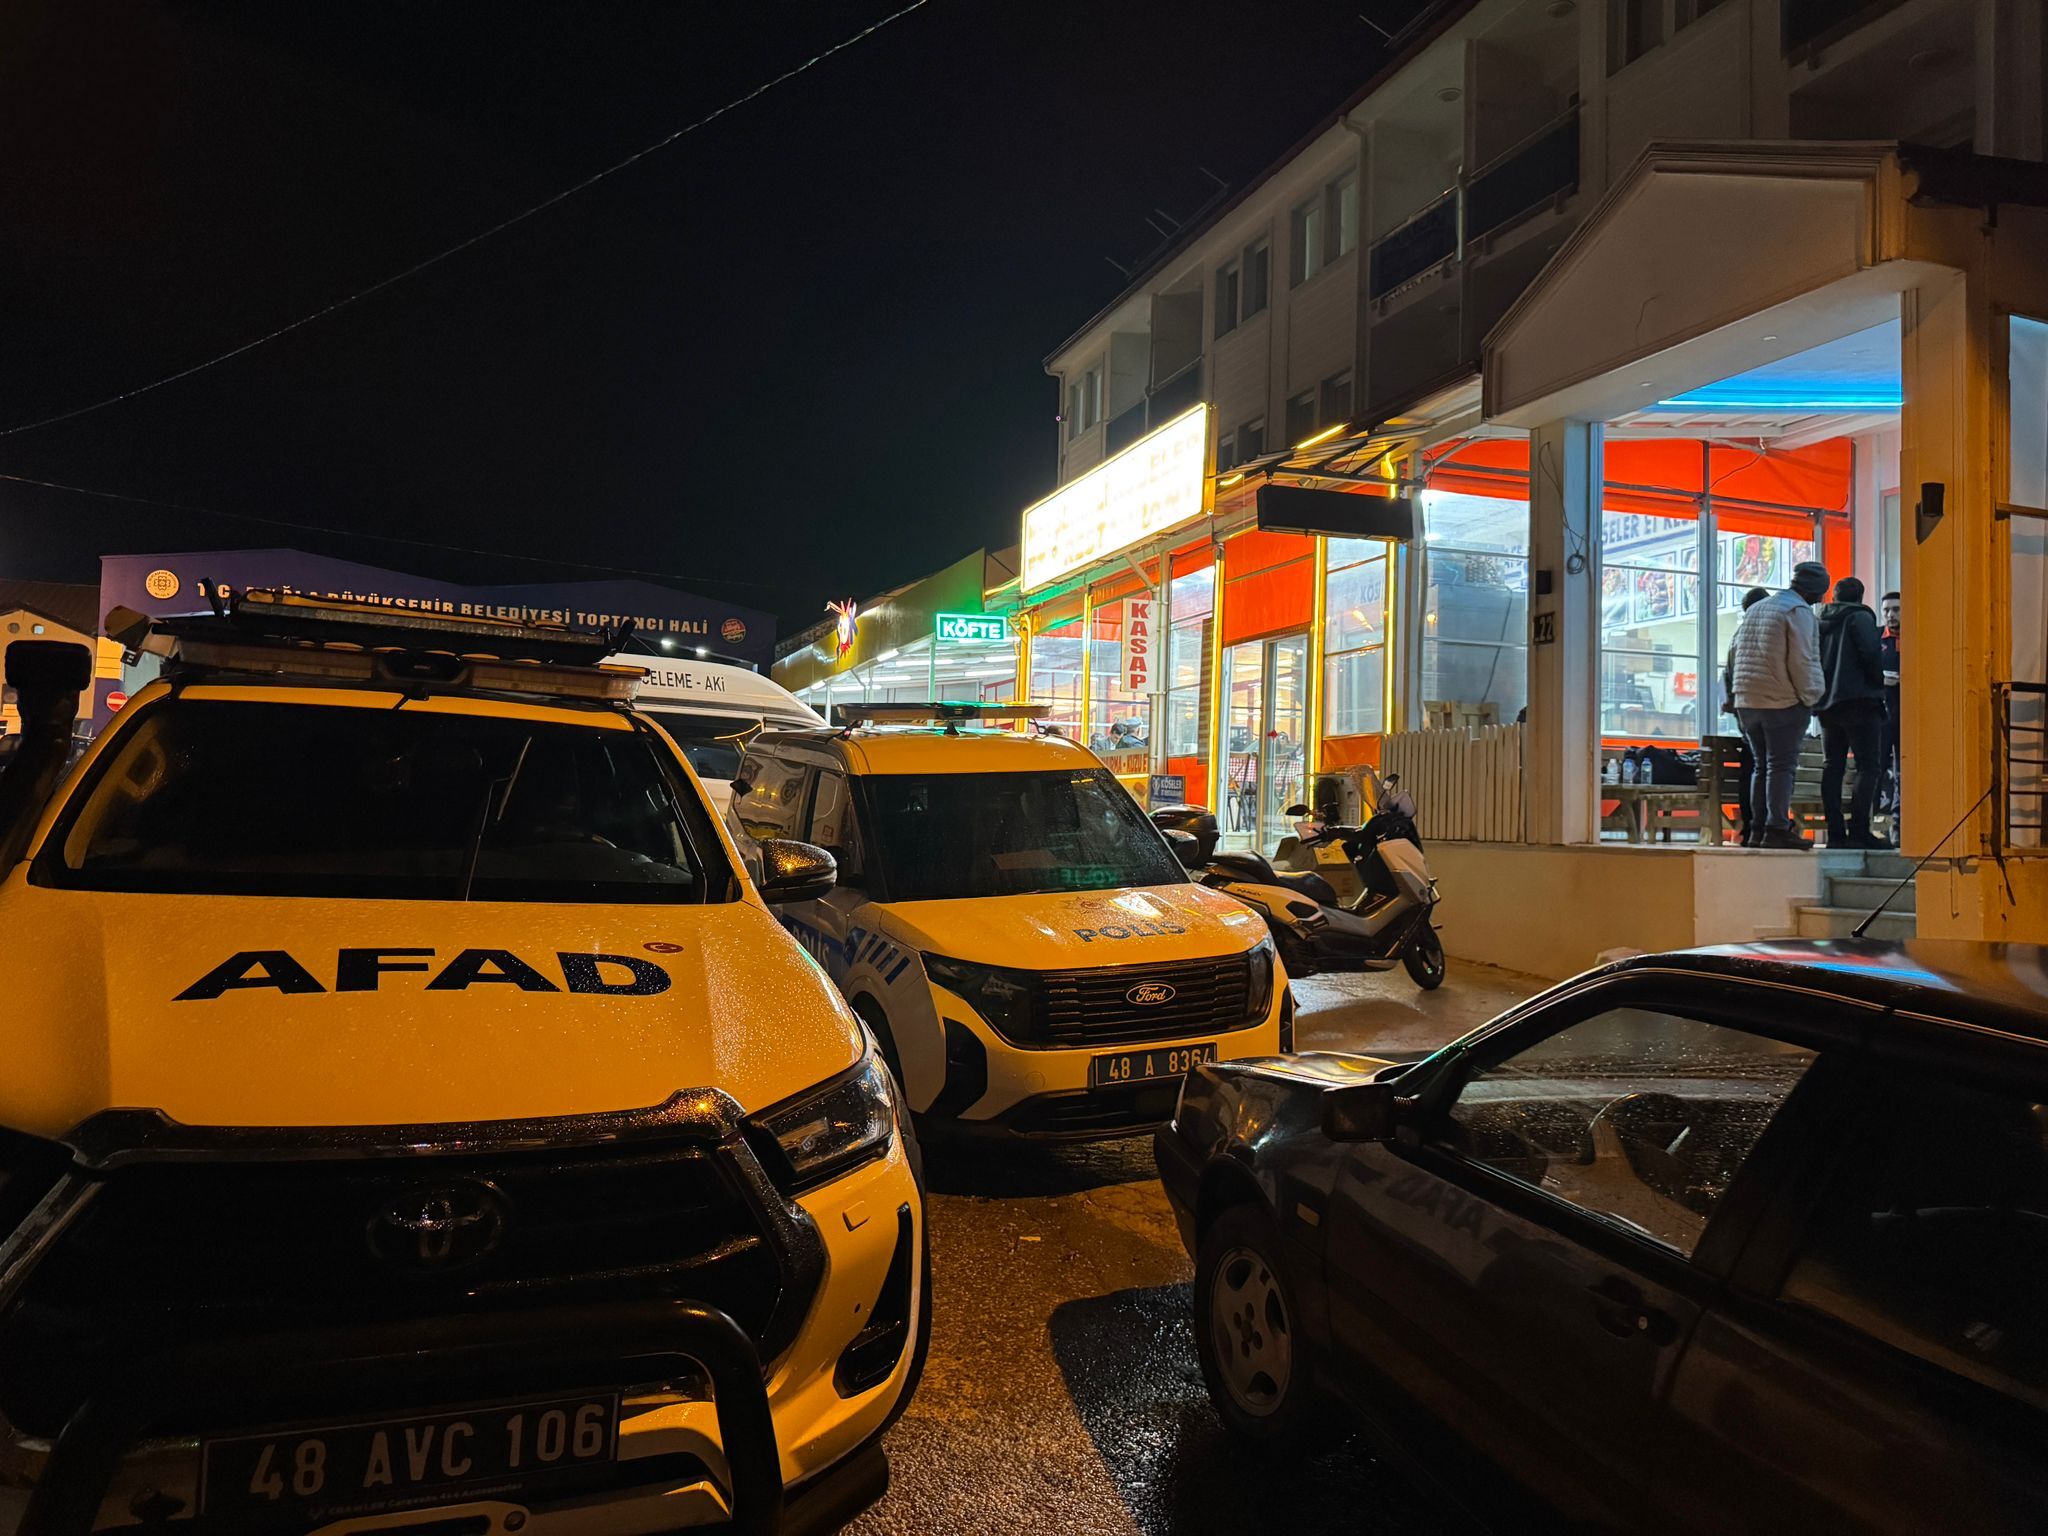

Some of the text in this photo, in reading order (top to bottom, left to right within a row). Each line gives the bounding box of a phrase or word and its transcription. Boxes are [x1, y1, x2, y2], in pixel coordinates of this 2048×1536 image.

[461, 603, 570, 624] BELEDİYESİ
[669, 619, 709, 634] HALİ
[942, 617, 1001, 639] KÖFTE
[1129, 602, 1149, 690] KASAP
[170, 947, 672, 1001] AFAD
[1136, 986, 1166, 1002] Ford
[1109, 1047, 1211, 1080] 48 A 8364
[249, 1403, 605, 1500] 48 AVC 106
